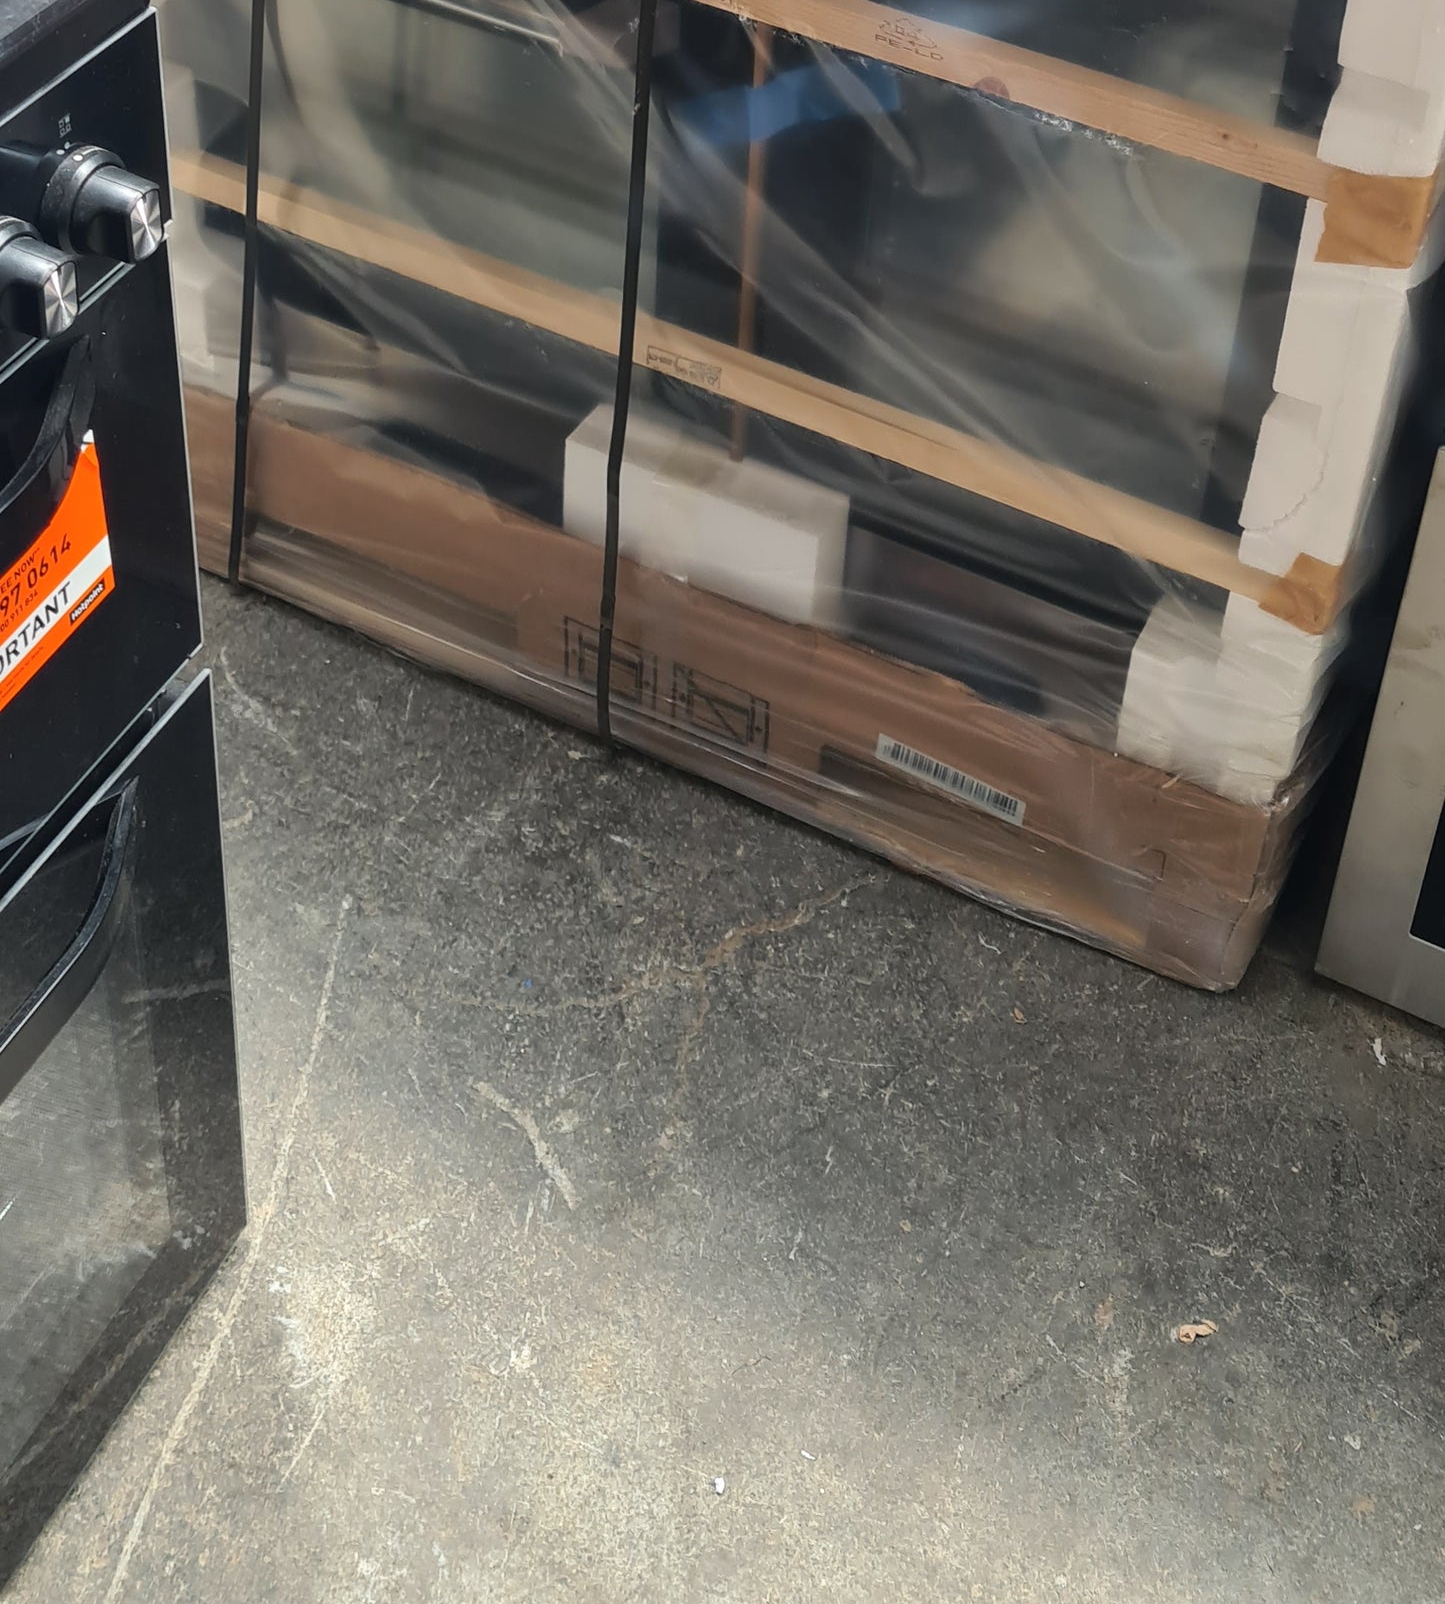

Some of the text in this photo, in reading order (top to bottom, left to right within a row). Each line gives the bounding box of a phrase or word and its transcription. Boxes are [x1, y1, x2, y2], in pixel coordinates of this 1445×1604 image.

[874, 33, 944, 62] PE-LD
[27, 533, 72, 589] 0614
[70, 583, 105, 621] Hotpoint
